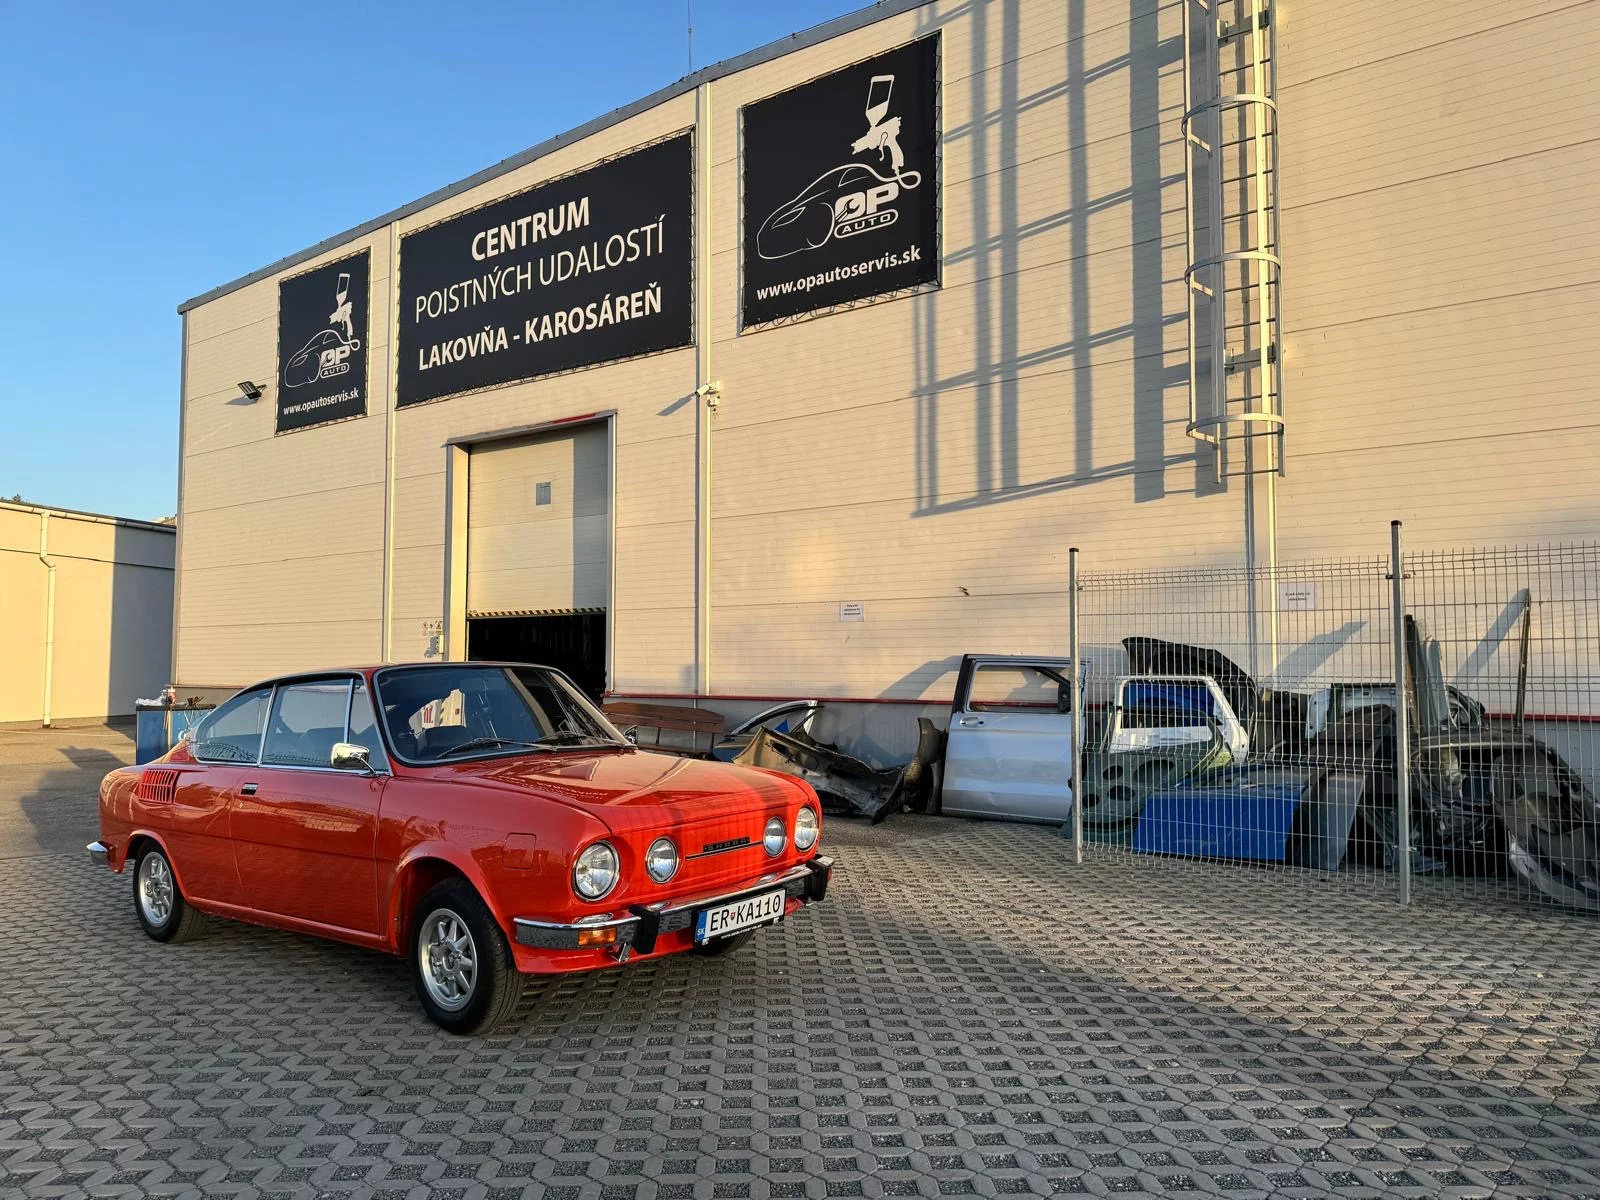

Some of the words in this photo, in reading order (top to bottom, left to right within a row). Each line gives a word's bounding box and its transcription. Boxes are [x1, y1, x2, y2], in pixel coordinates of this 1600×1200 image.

[835, 182, 899, 222] OP
[841, 212, 891, 234] AUTO
[471, 197, 590, 261] CENTRUM
[415, 262, 532, 324] POISTNÝCH
[539, 214, 666, 286] UDALOSTÍ
[756, 244, 922, 301] www.opautoservis.sk
[419, 325, 508, 371] LAKOVŇA
[525, 281, 662, 344] KAROSÁREŇ
[323, 365, 347, 376] AUTO
[283, 387, 359, 416] www.opautoservis.sk
